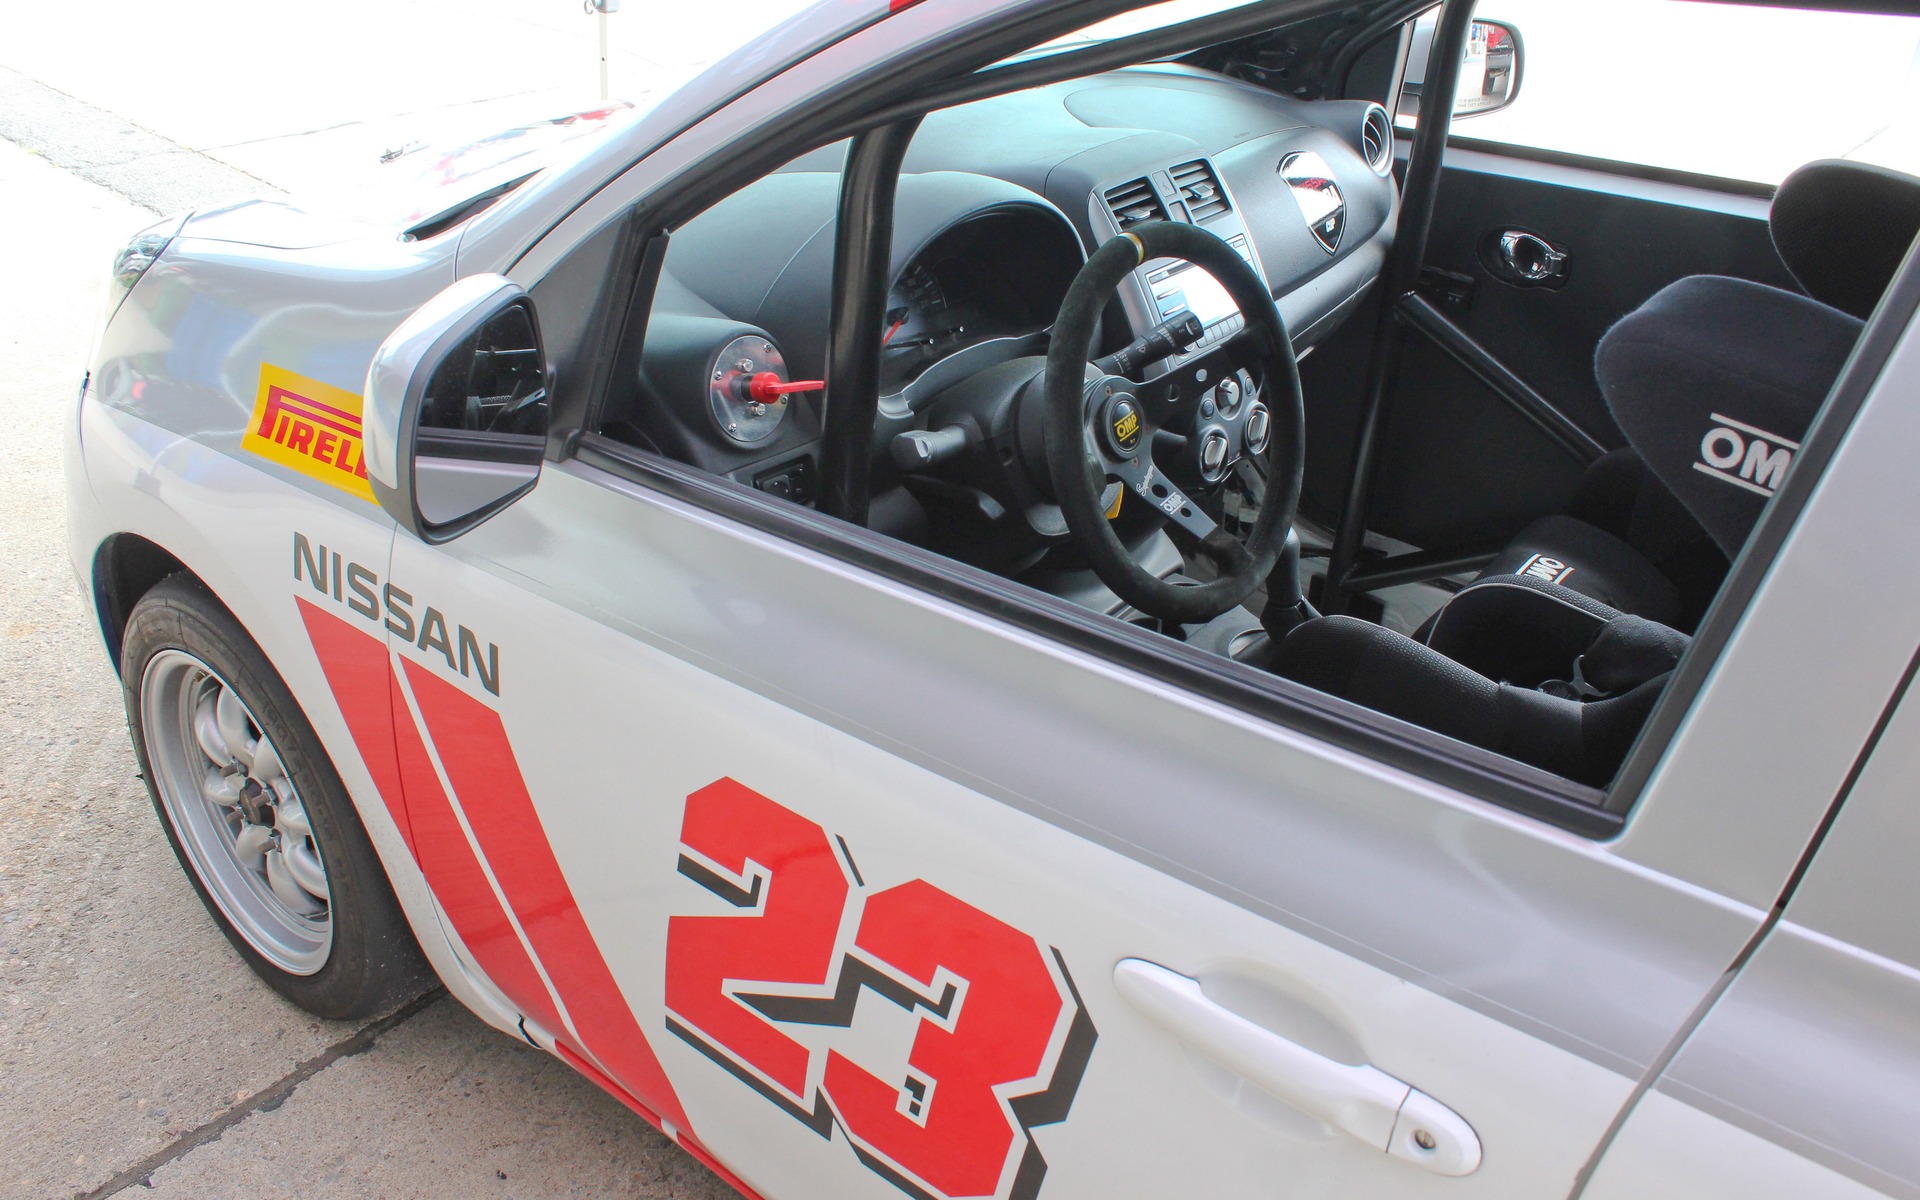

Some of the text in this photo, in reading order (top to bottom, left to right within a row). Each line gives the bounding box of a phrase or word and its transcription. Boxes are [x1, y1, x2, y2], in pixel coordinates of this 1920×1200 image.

[1116, 413, 1138, 438] OMP
[1163, 494, 1182, 512] OMP
[293, 531, 500, 698] NISSAN
[664, 775, 1098, 1200] 23
